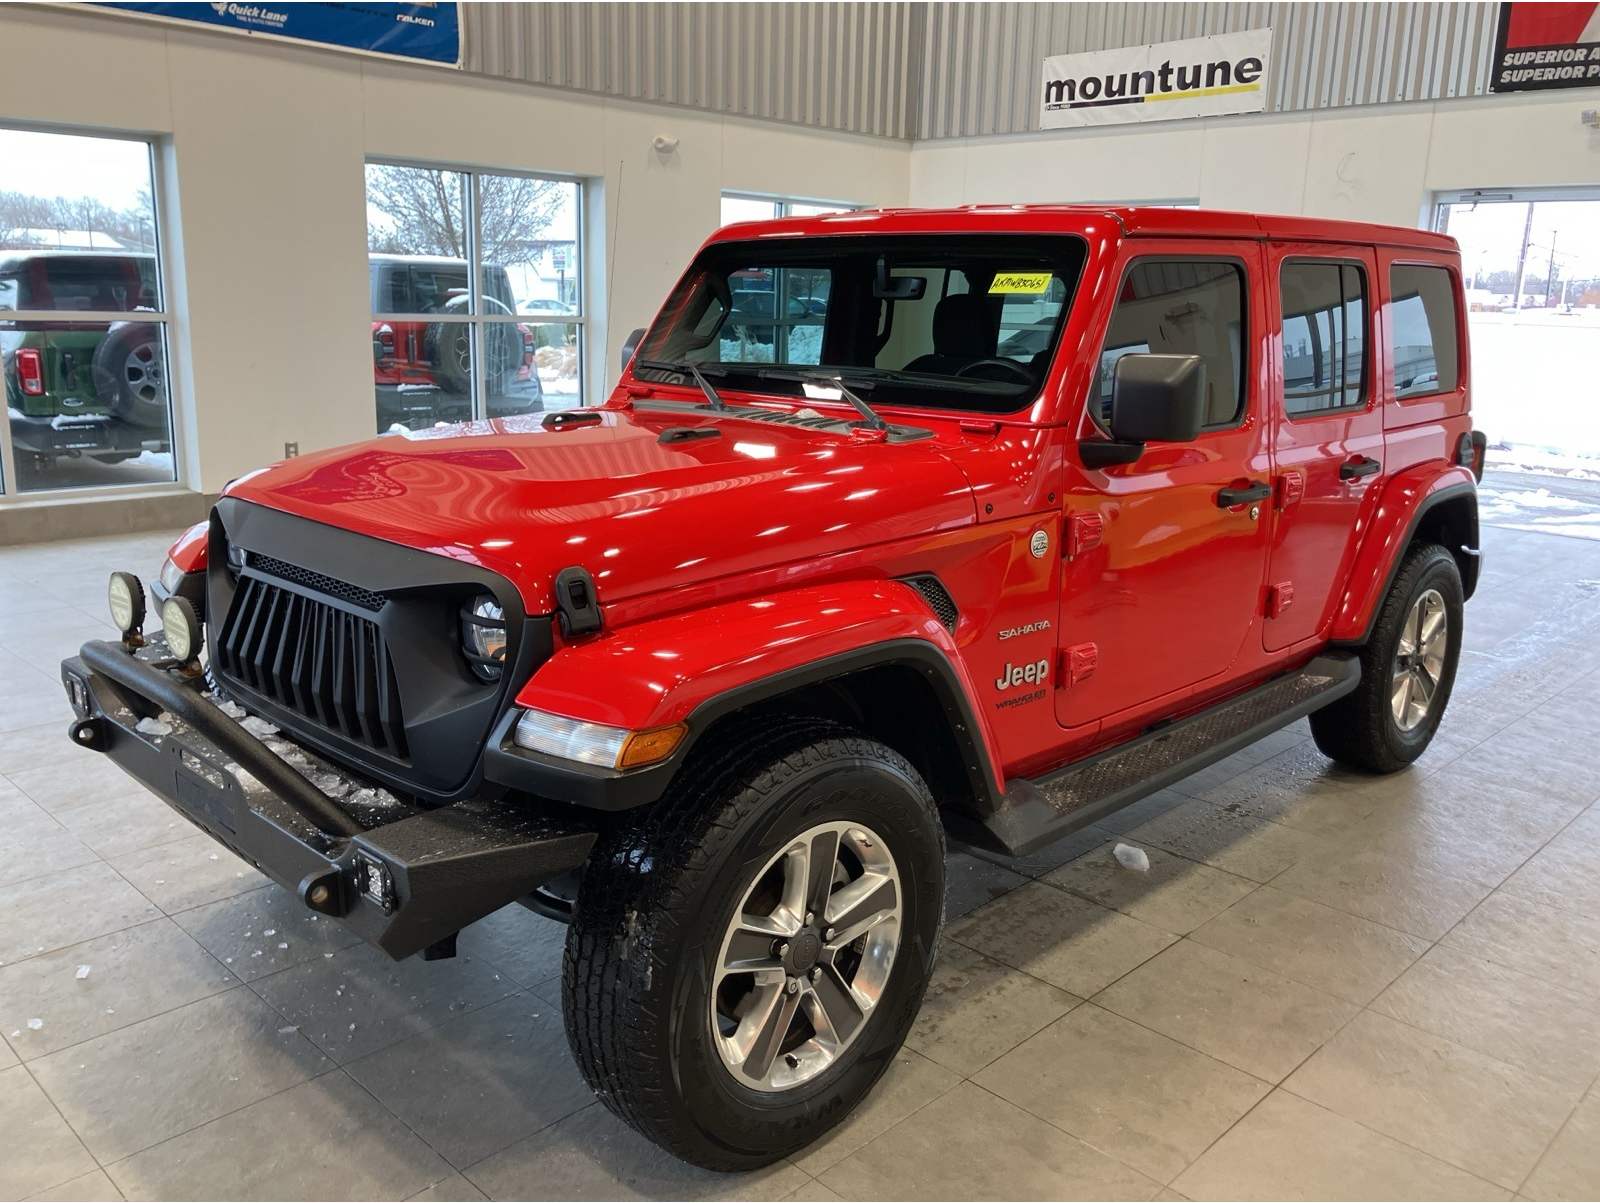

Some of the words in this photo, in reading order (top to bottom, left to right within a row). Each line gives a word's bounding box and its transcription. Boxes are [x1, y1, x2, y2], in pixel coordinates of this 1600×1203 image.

[228, 3, 260, 18] Quick
[260, 9, 289, 23] Lane
[396, 14, 435, 27] FALKEN
[1502, 48, 1588, 66] SUPERIOR
[1045, 57, 1263, 103] mountune
[1500, 65, 1585, 83] SUPERIOR
[1586, 64, 1600, 78] P
[999, 620, 1051, 641] SAHARA
[996, 659, 1049, 690] Jeep
